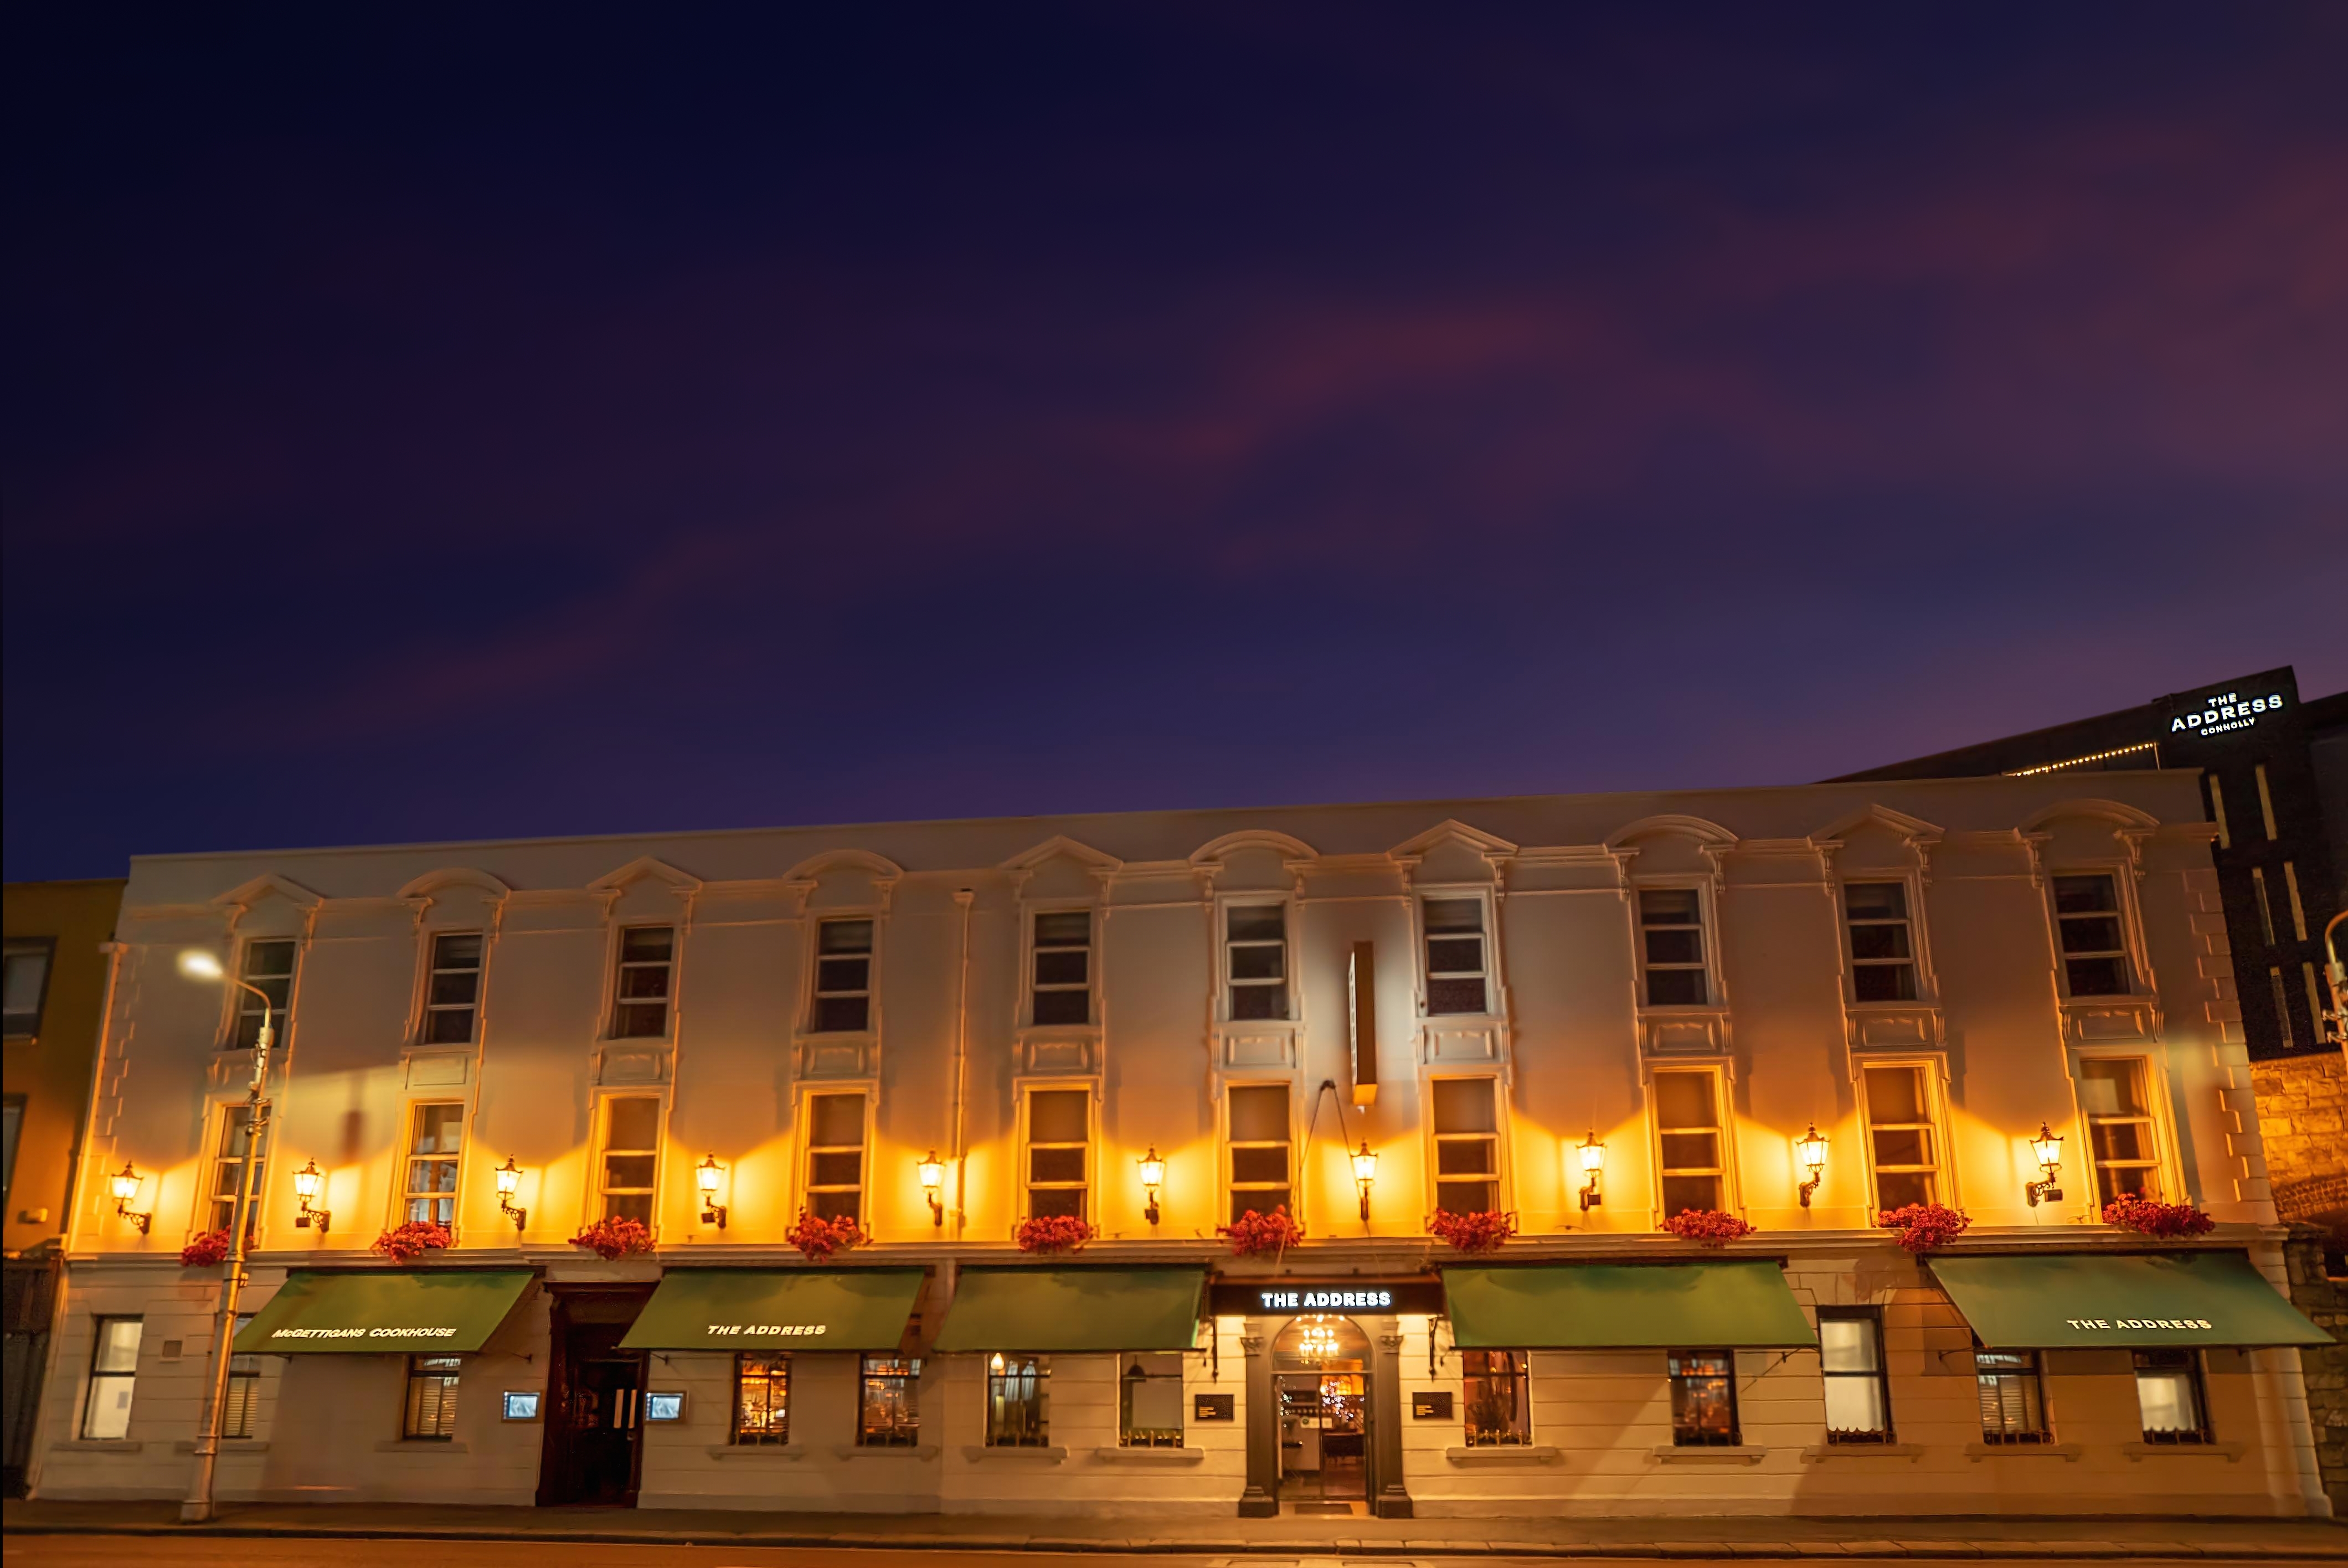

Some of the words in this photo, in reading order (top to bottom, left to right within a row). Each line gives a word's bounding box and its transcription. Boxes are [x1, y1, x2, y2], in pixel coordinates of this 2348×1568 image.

[2208, 693, 2237, 707] THE
[2171, 694, 2283, 732] ADDRESS
[2201, 717, 2256, 735] CONNOLLY
[1261, 1293, 1299, 1307] THE
[1304, 1292, 1391, 1307] ADDRESS
[708, 1325, 742, 1335] THE
[743, 1325, 826, 1335] ADDRESS
[2066, 1319, 2111, 1329] THE
[2116, 1319, 2212, 1329] ADDRESS
[369, 1328, 457, 1338] COOKHOUSE
